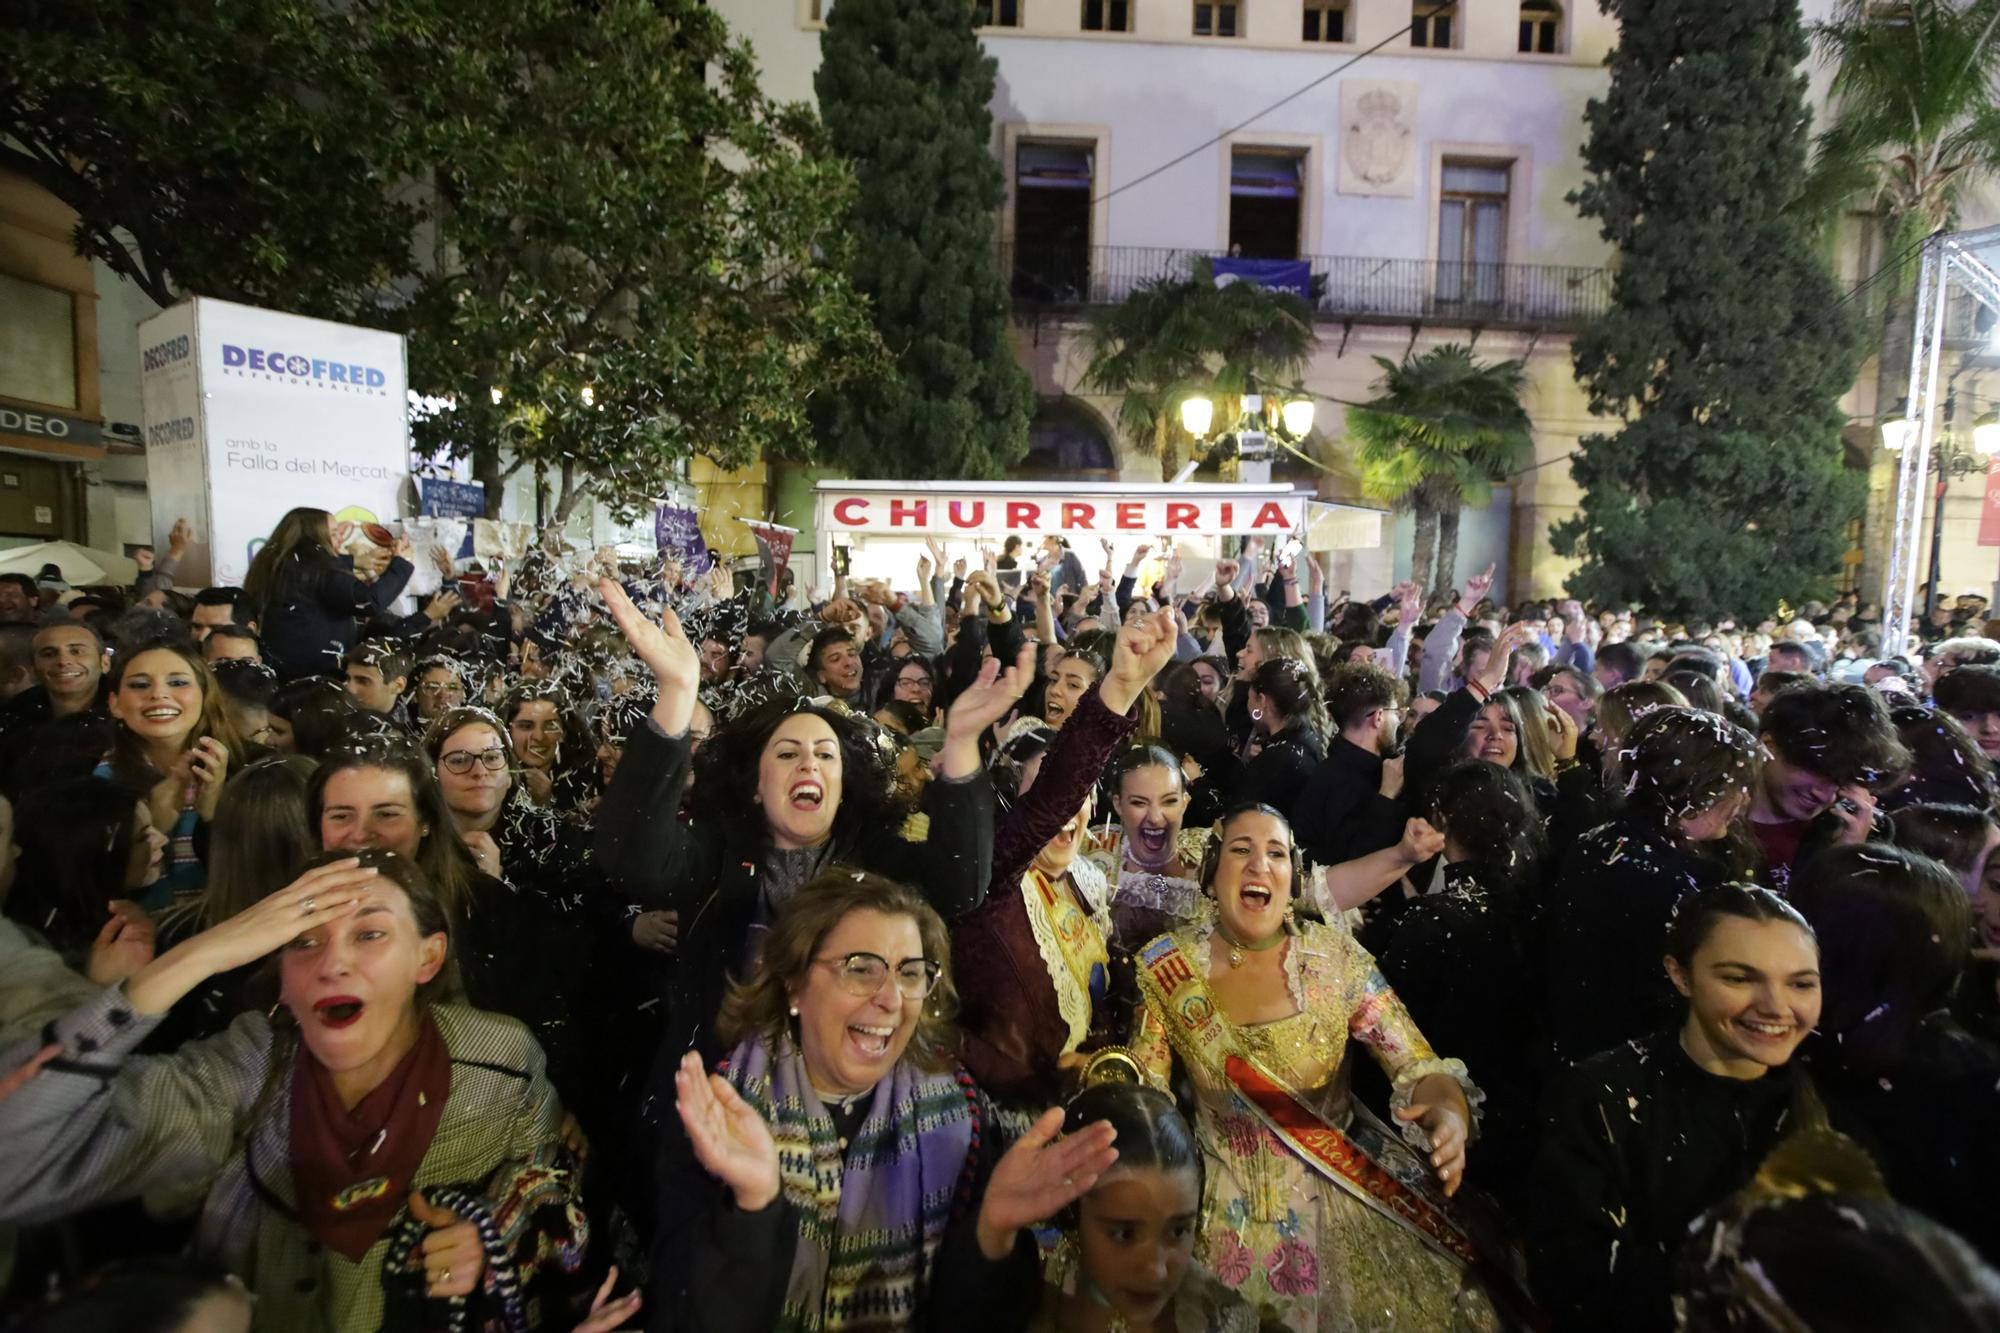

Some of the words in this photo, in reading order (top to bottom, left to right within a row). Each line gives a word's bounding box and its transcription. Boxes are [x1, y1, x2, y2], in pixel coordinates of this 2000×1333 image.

[222, 344, 386, 388] DECOFRED
[0, 409, 69, 437] DEO
[225, 437, 260, 451] amb
[264, 440, 278, 452] la
[227, 451, 279, 472] Falla
[285, 458, 316, 474] del
[322, 460, 389, 480] Mercat
[833, 498, 1291, 530] CHURRERIA
[1199, 1022, 1223, 1047] 2023
